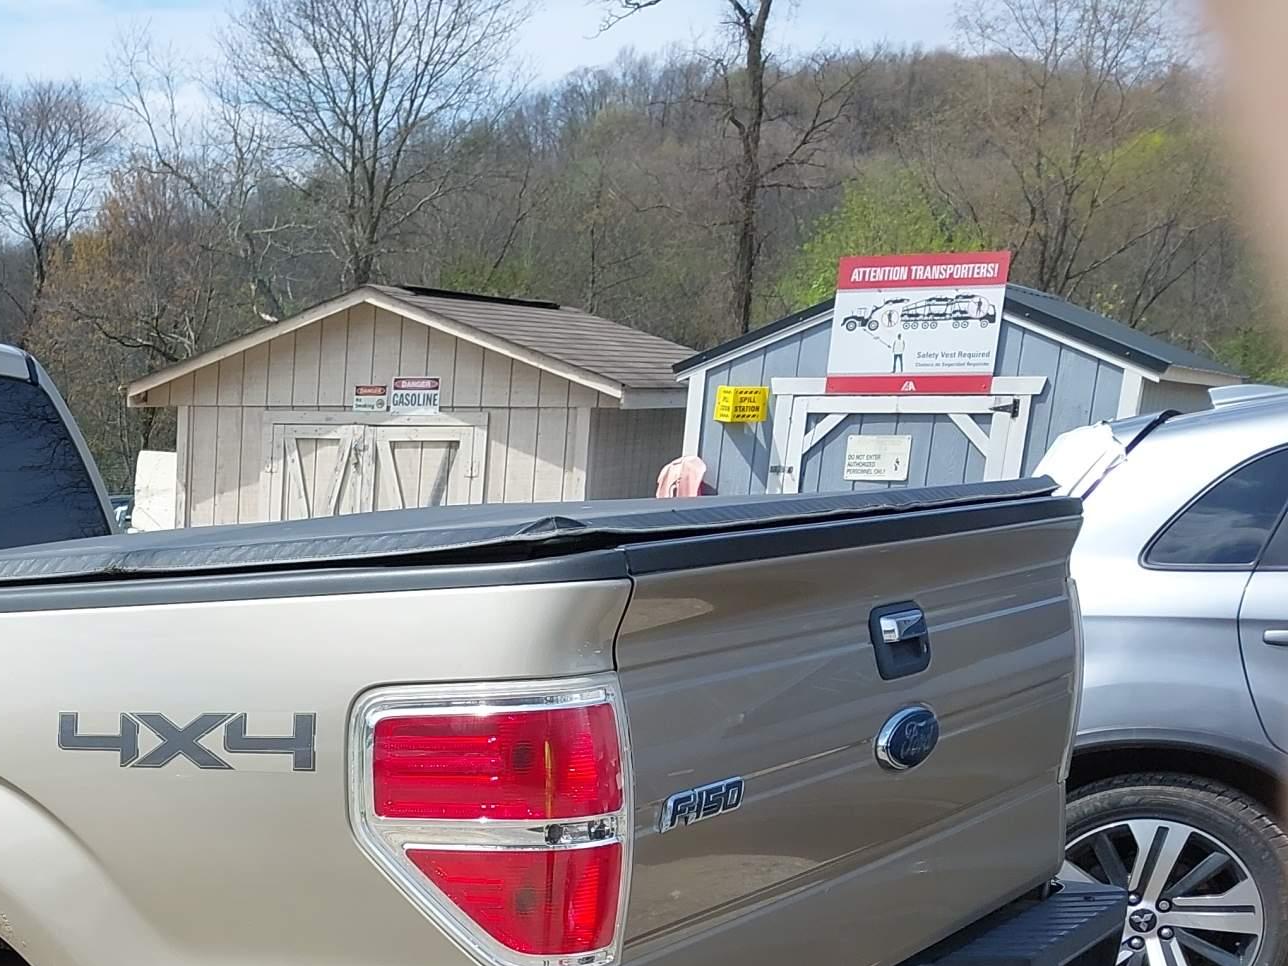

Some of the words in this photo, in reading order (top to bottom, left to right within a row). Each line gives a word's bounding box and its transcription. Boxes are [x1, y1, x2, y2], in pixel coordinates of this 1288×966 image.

[851, 267, 908, 281] ATTENTION
[911, 264, 999, 279] TRANSPORTERS!
[917, 352, 939, 360] Safety
[958, 351, 990, 359] Required
[401, 380, 431, 388] DANGER
[393, 393, 438, 406] GASOLINE
